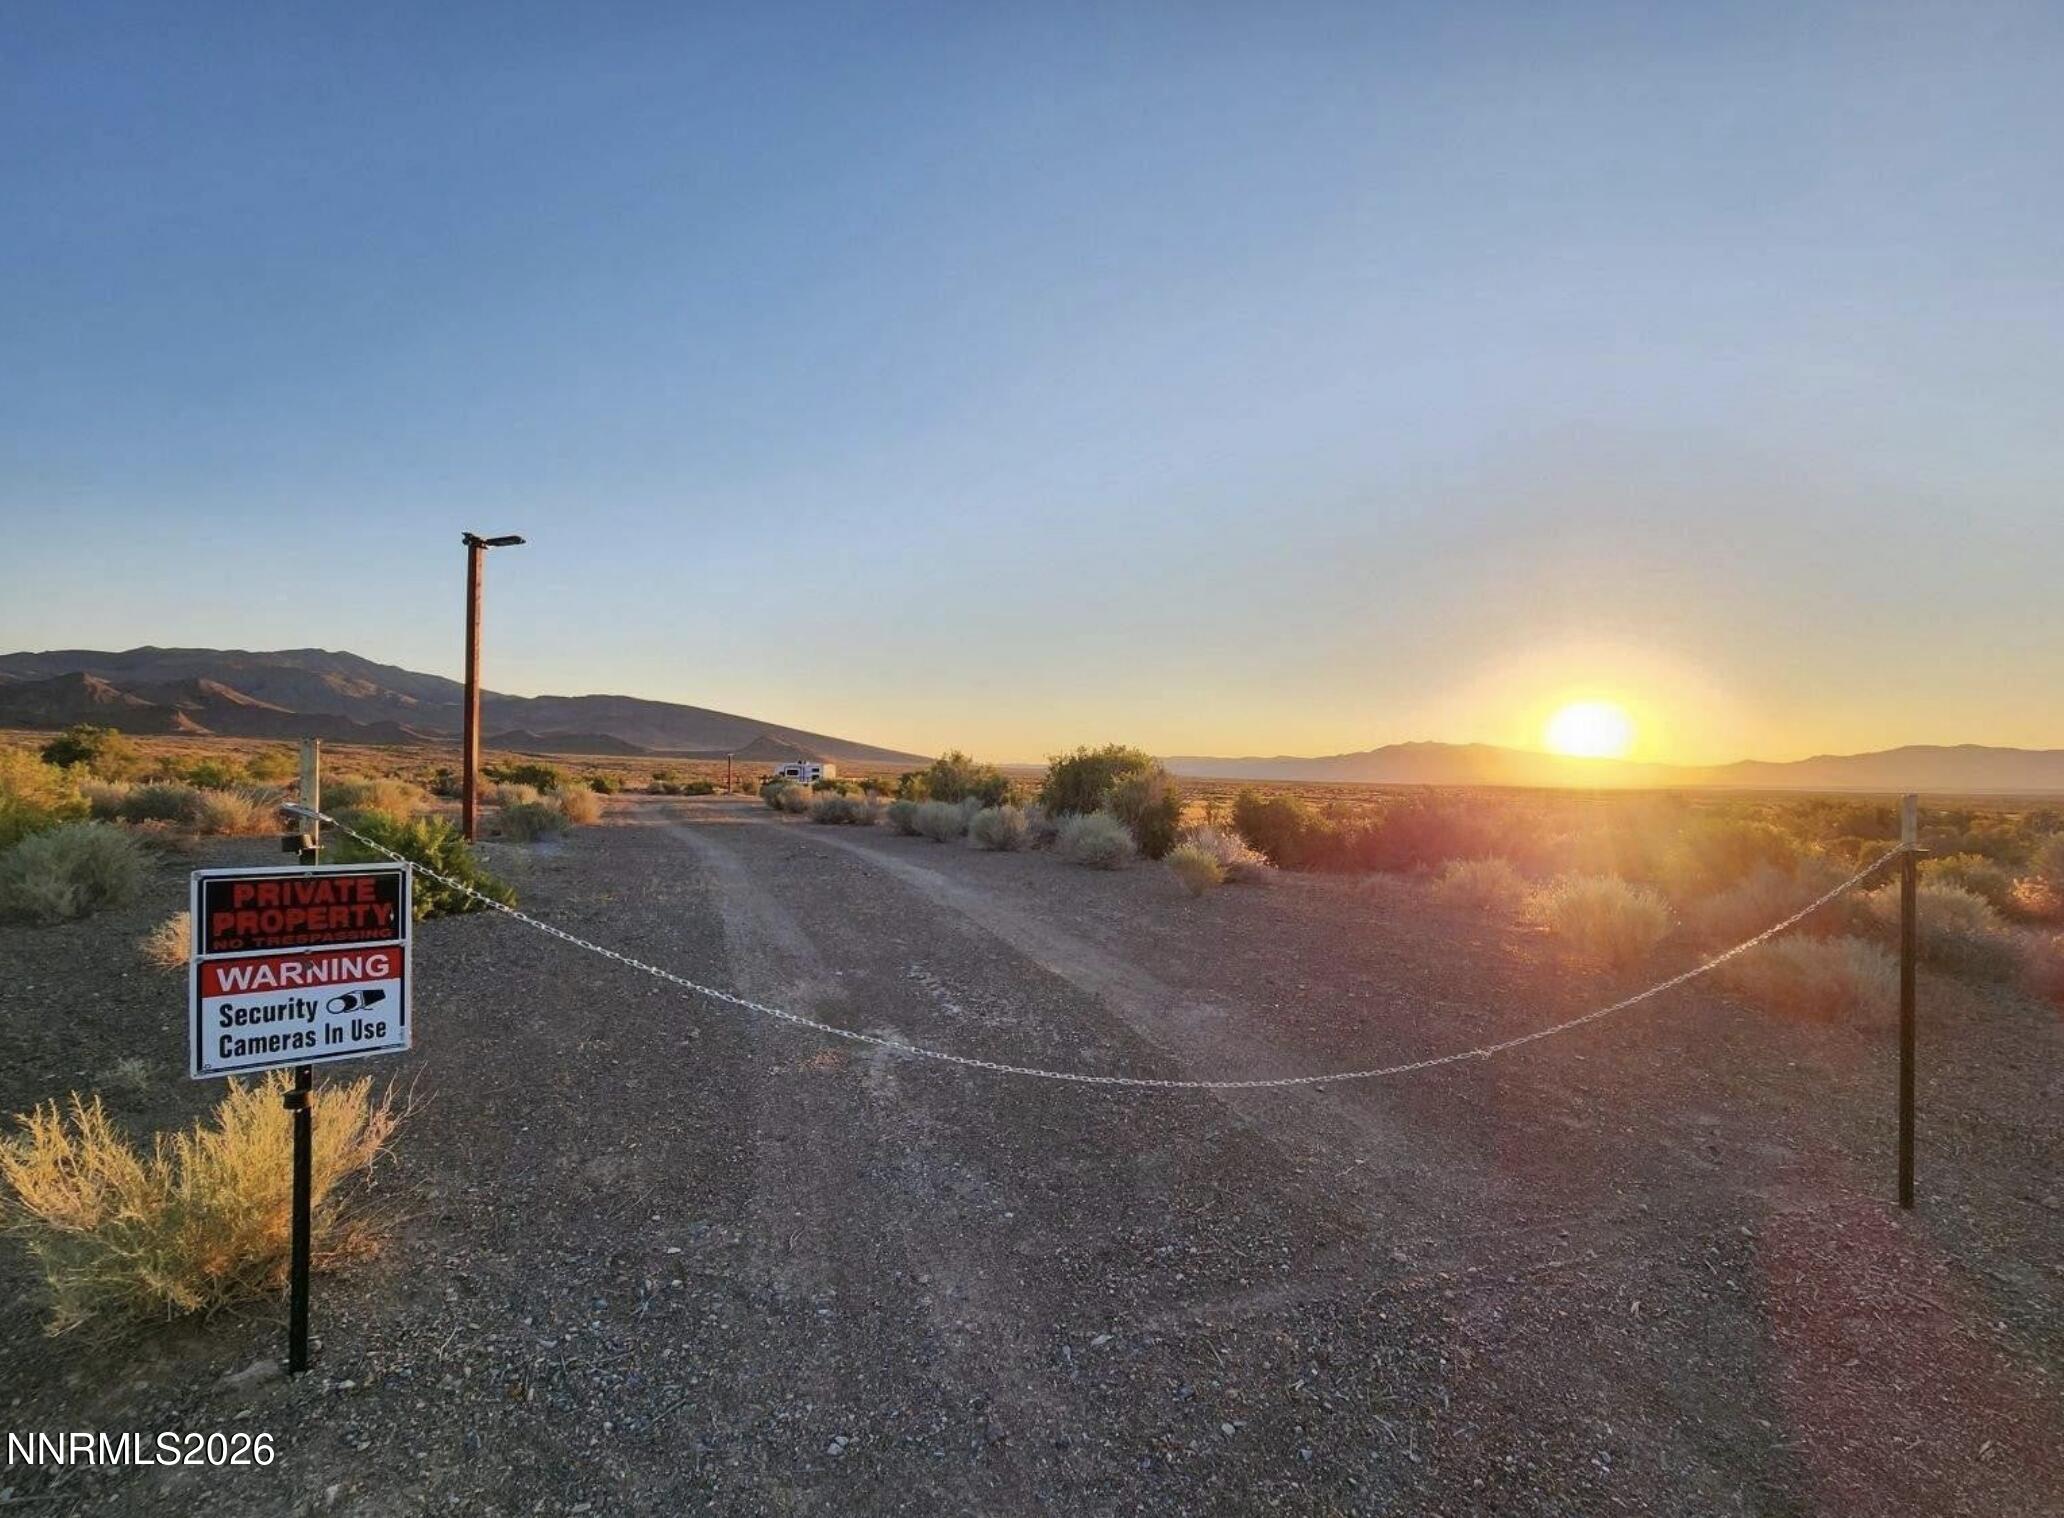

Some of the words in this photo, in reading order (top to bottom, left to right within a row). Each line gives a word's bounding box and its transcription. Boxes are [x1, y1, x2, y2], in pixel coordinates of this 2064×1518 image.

[233, 877, 377, 908] PRIVATE
[212, 903, 392, 937] PROPERTY
[213, 939, 243, 950] NO
[255, 928, 394, 948] TRESPASSING
[216, 954, 390, 992] WARNING
[219, 998, 318, 1028] Security
[219, 1030, 317, 1059] Cameras
[325, 1023, 343, 1045] In
[351, 1019, 387, 1042] Use
